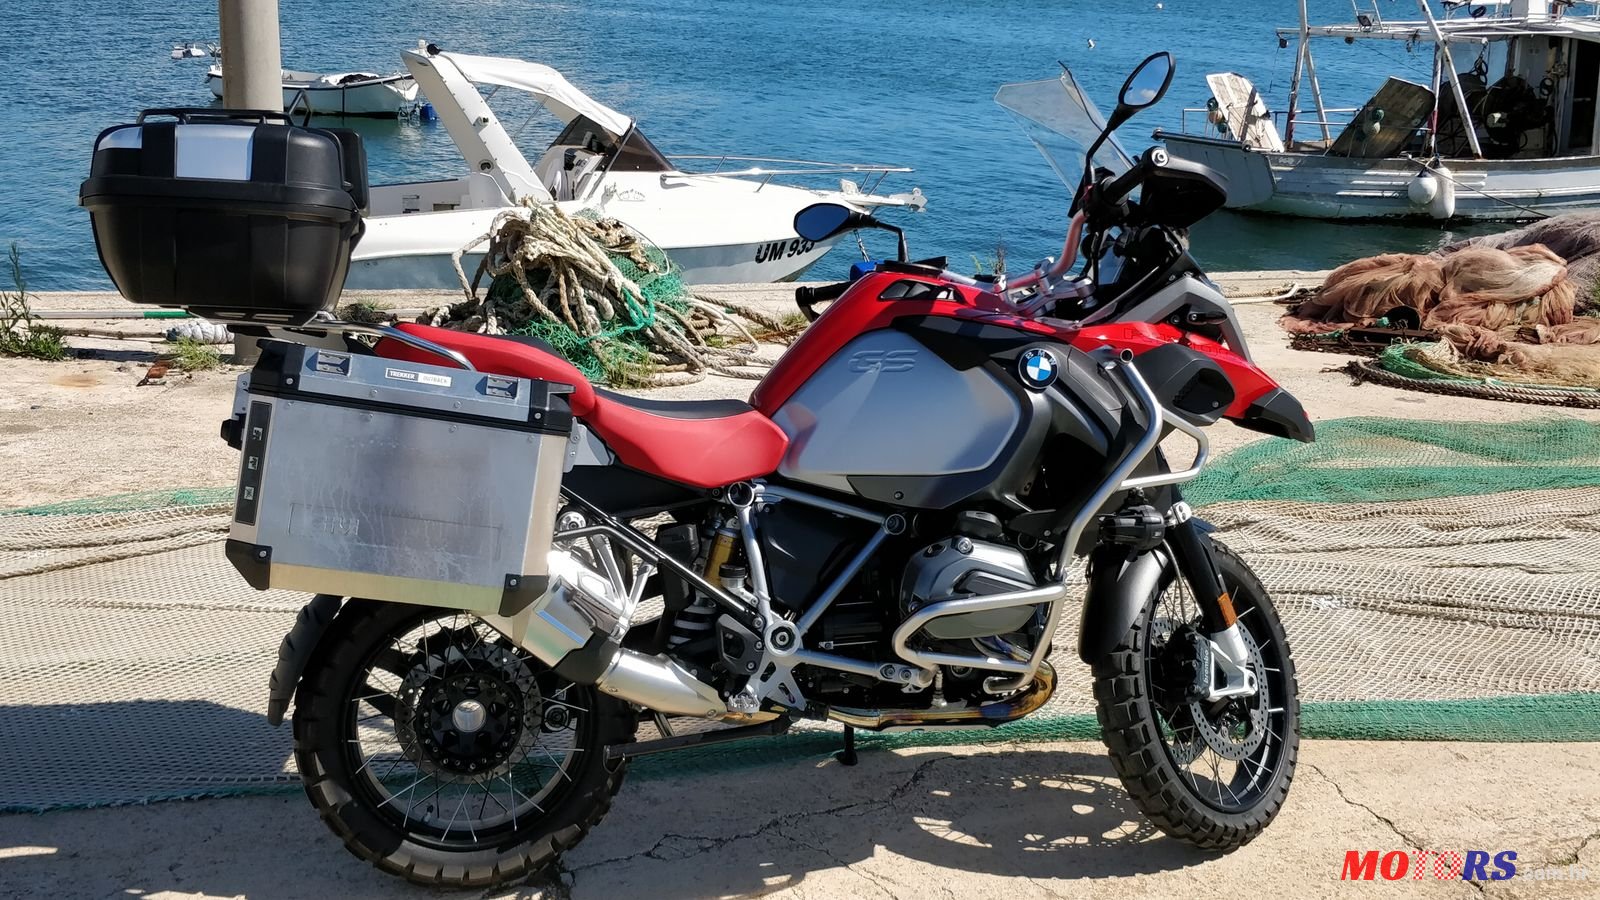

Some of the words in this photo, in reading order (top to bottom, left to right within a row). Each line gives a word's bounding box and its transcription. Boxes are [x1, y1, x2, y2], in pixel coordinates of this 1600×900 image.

[755, 241, 786, 264] UM
[848, 350, 919, 373] GS
[1025, 350, 1057, 366] BMW
[389, 370, 416, 380] TREKKER
[422, 375, 448, 385] OUTBACK
